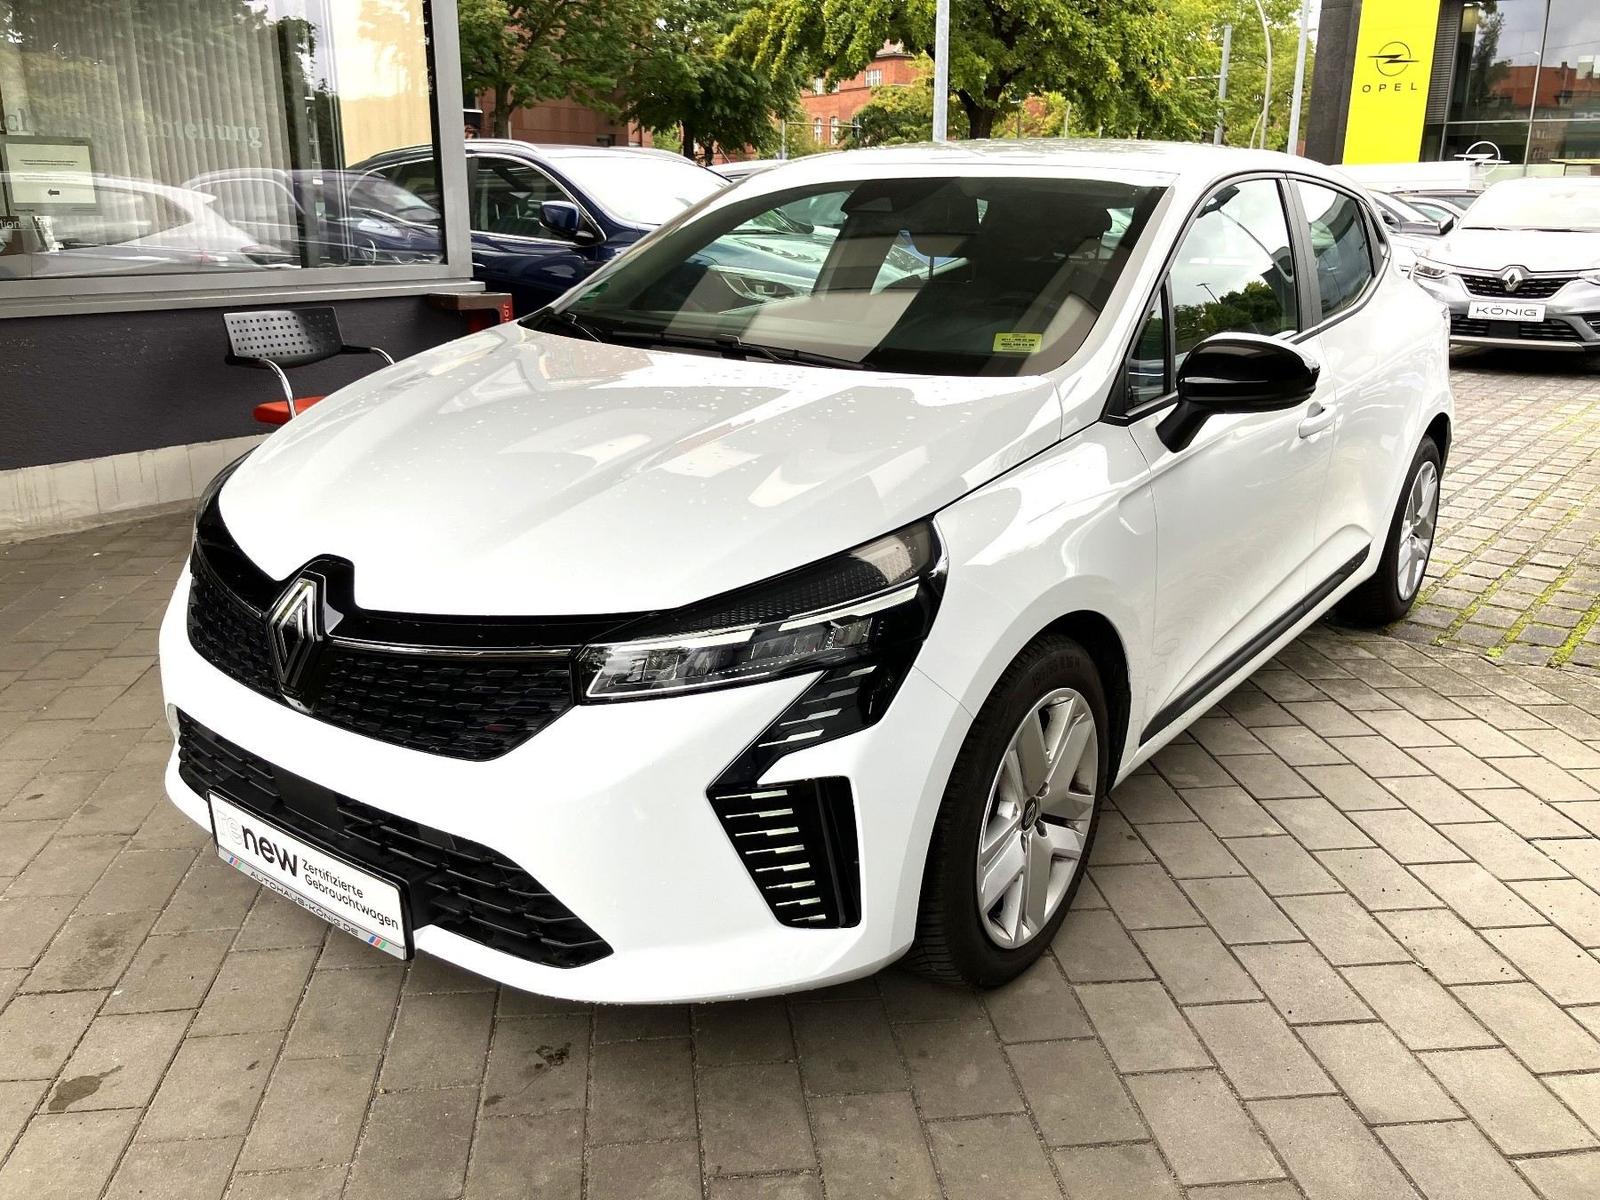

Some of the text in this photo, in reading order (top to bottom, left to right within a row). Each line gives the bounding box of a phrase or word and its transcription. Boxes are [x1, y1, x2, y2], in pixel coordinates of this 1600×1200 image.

[1361, 82, 1417, 93] OPEL
[1475, 305, 1537, 316] KÖNIG
[302, 858, 364, 898] Zertifizierte
[304, 874, 399, 930] Gebrauchtwagen
